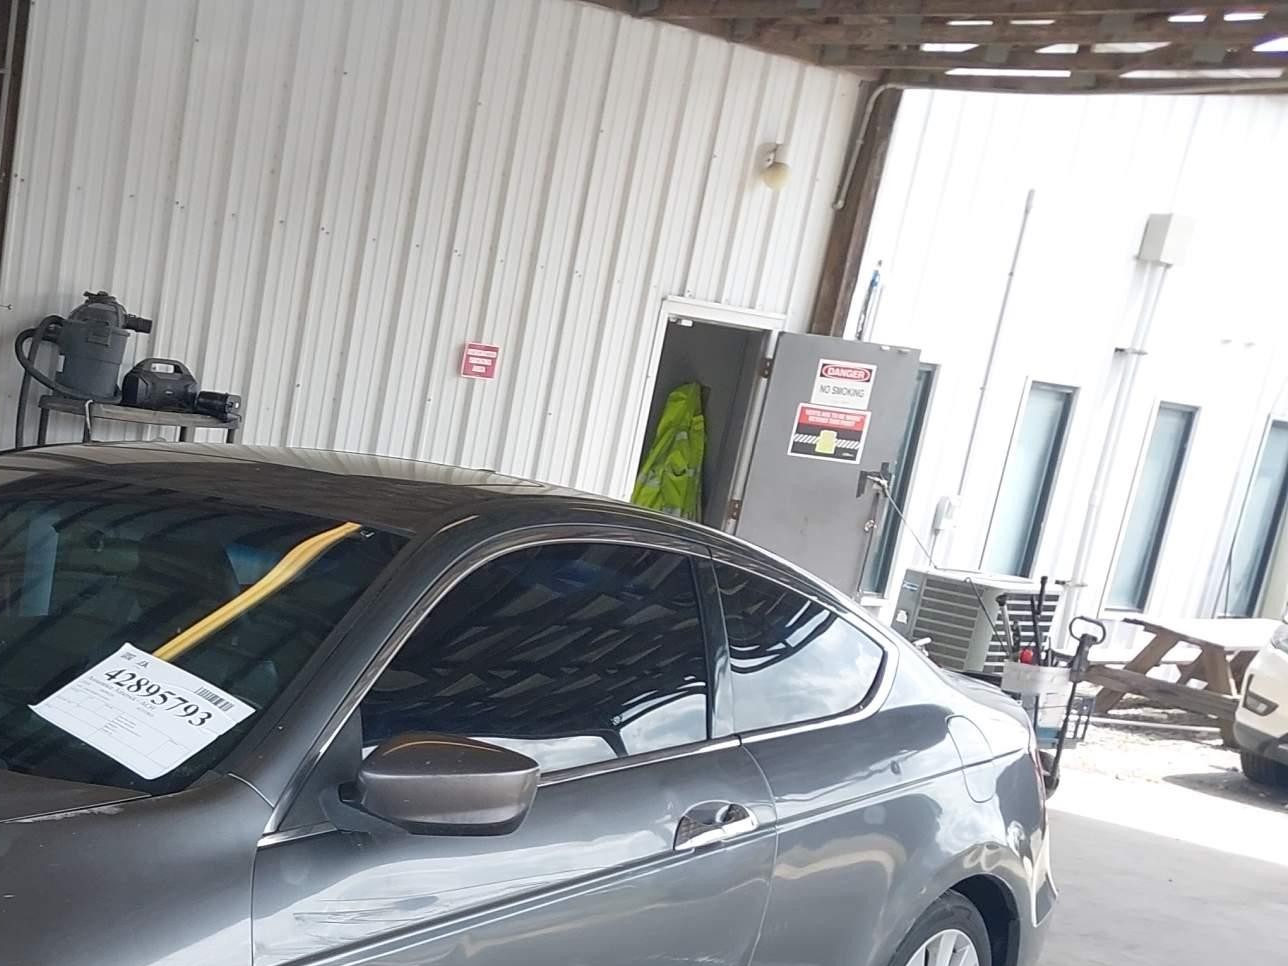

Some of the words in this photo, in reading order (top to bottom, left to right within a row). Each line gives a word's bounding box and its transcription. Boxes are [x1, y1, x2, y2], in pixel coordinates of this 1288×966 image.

[827, 367, 866, 379] DANGER
[819, 384, 831, 394] NO
[832, 385, 865, 398] SMOKING
[104, 668, 212, 727] 42895793
